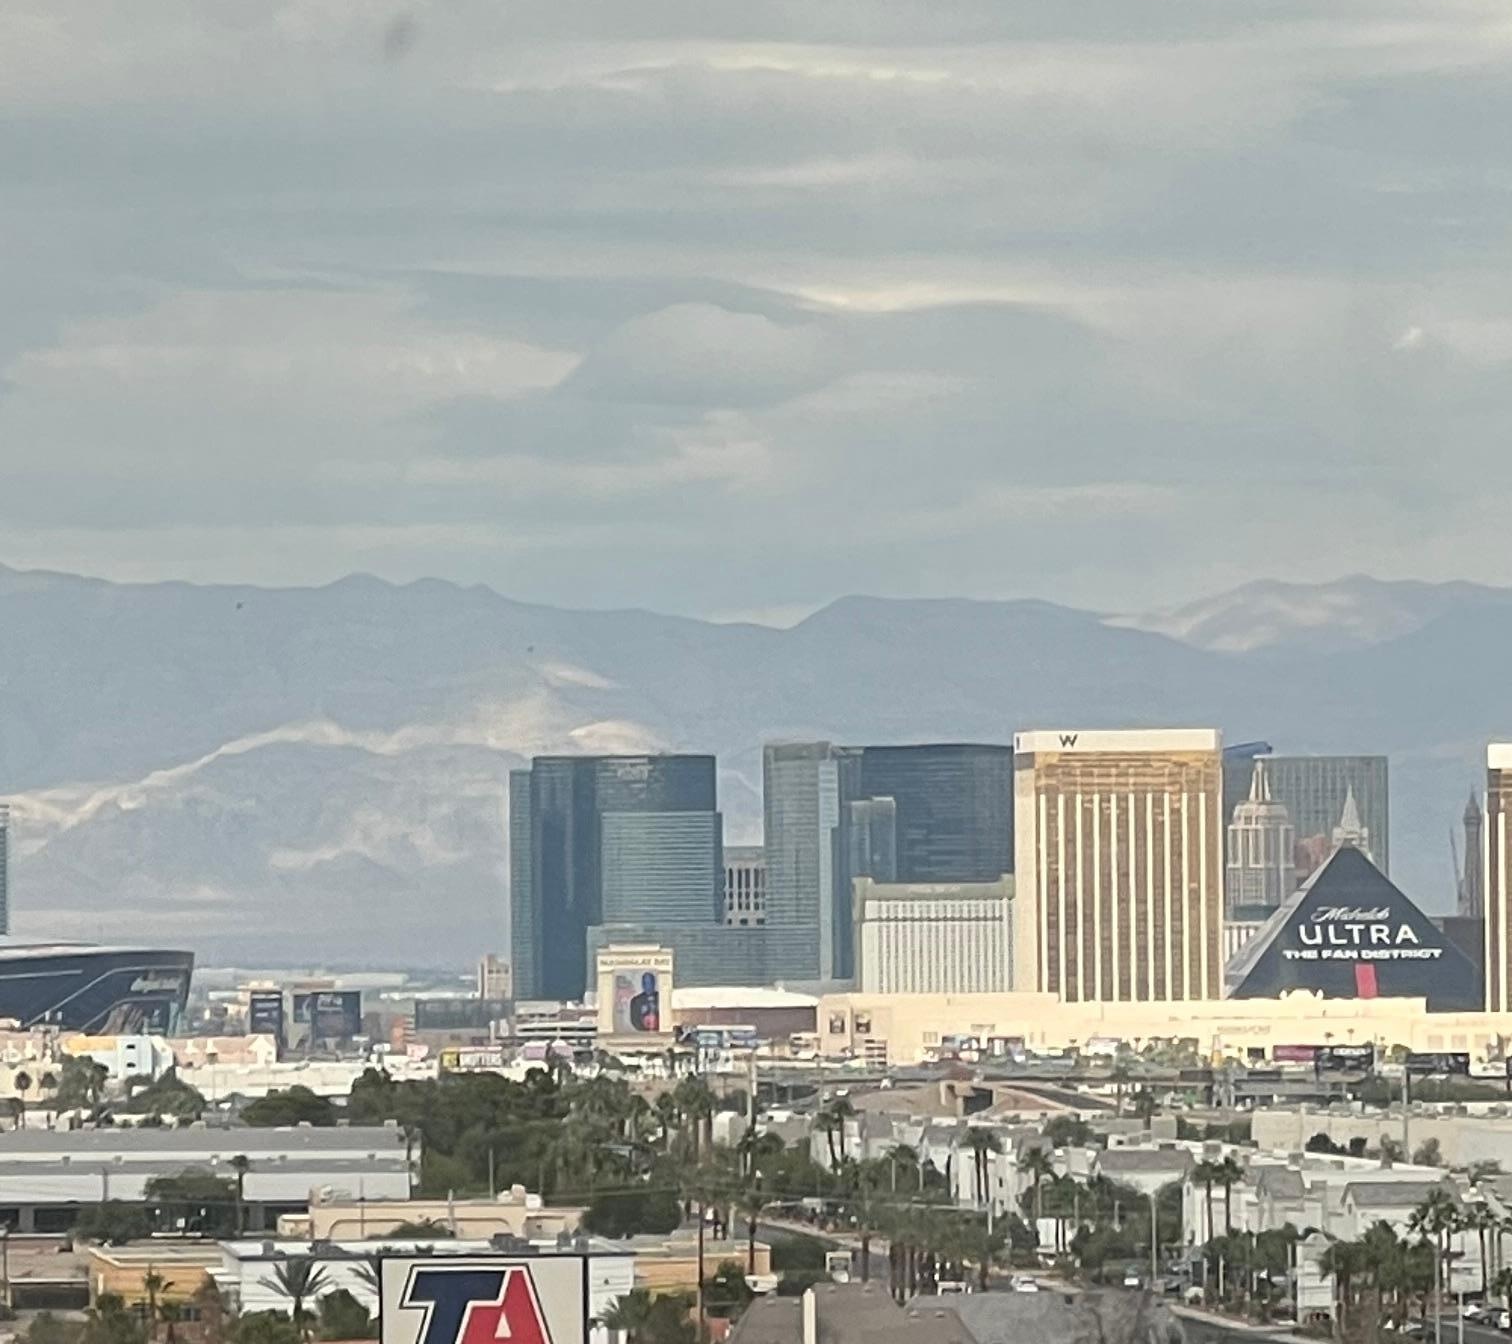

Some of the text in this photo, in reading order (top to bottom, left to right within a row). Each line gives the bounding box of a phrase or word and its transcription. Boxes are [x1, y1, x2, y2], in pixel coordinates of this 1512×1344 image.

[1059, 734, 1078, 748] W
[1299, 924, 1419, 945] ULTRA
[1282, 948, 1442, 960] THE FAN DISTRICT
